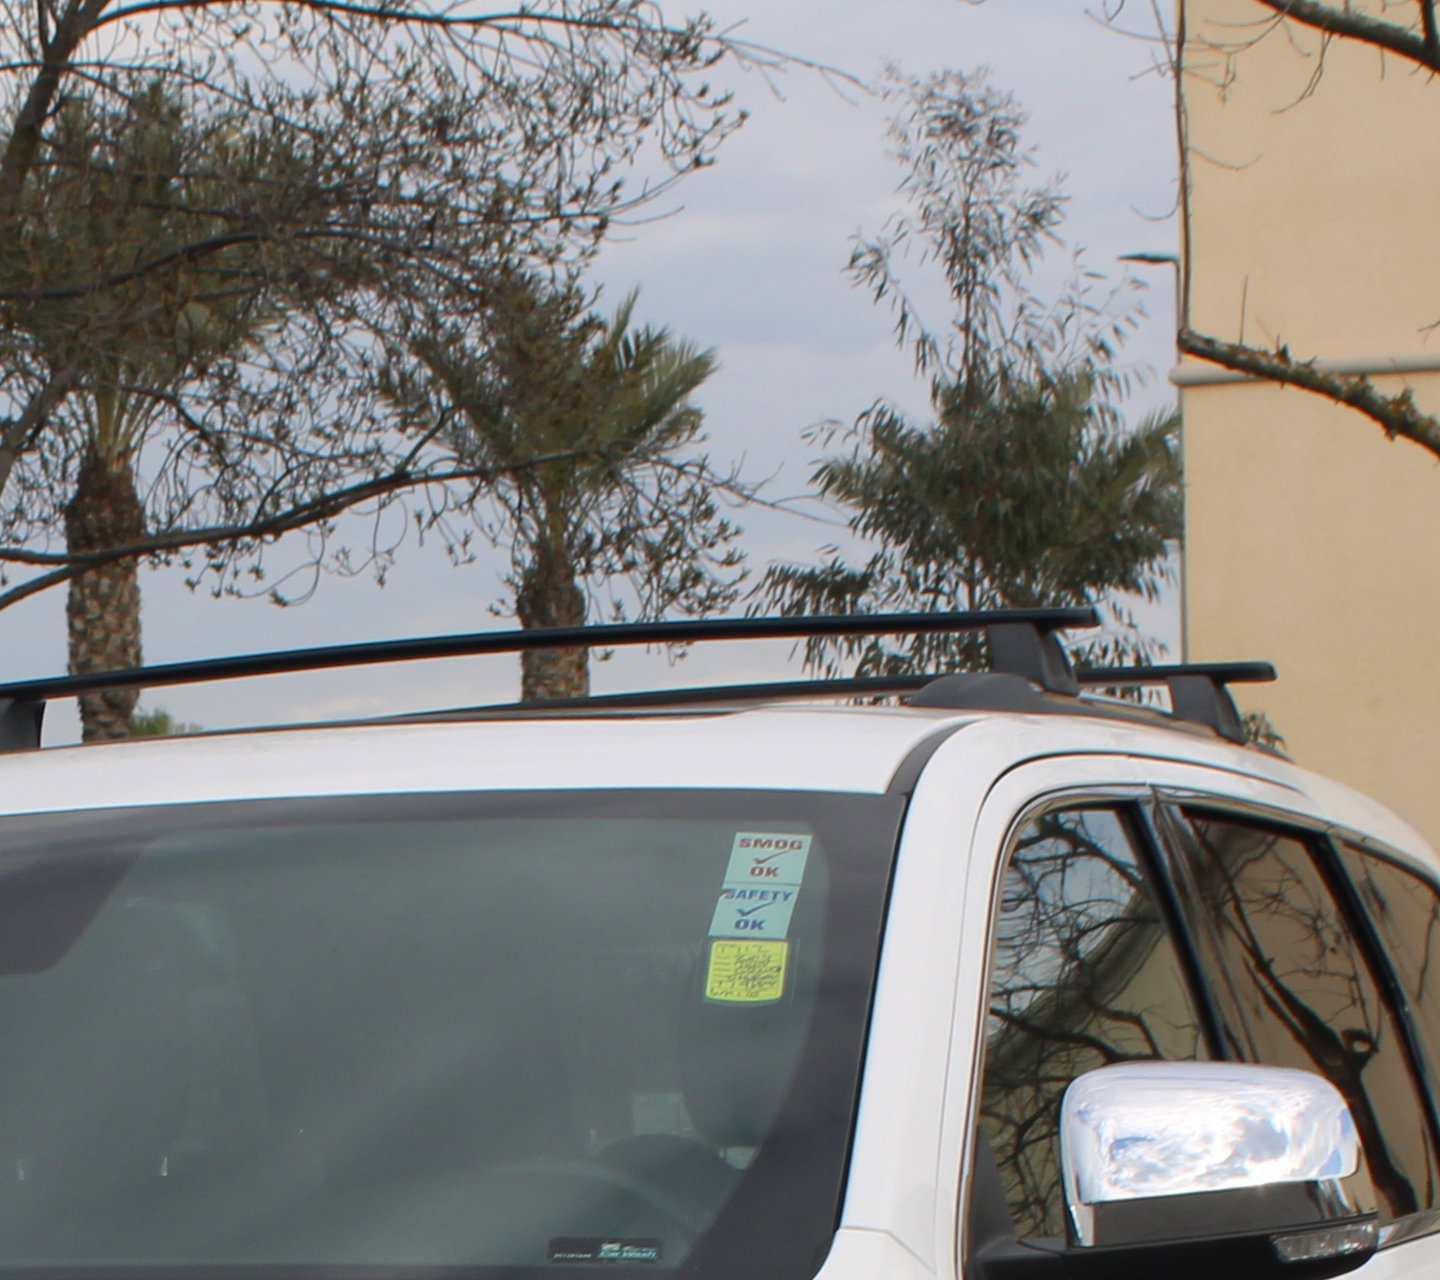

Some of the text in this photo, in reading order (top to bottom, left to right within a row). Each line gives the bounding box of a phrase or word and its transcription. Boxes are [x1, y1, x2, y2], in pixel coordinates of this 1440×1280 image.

[738, 837, 803, 850] SMOG
[749, 866, 780, 878] OK
[724, 889, 793, 902] SAFETY
[734, 918, 766, 931] OK
